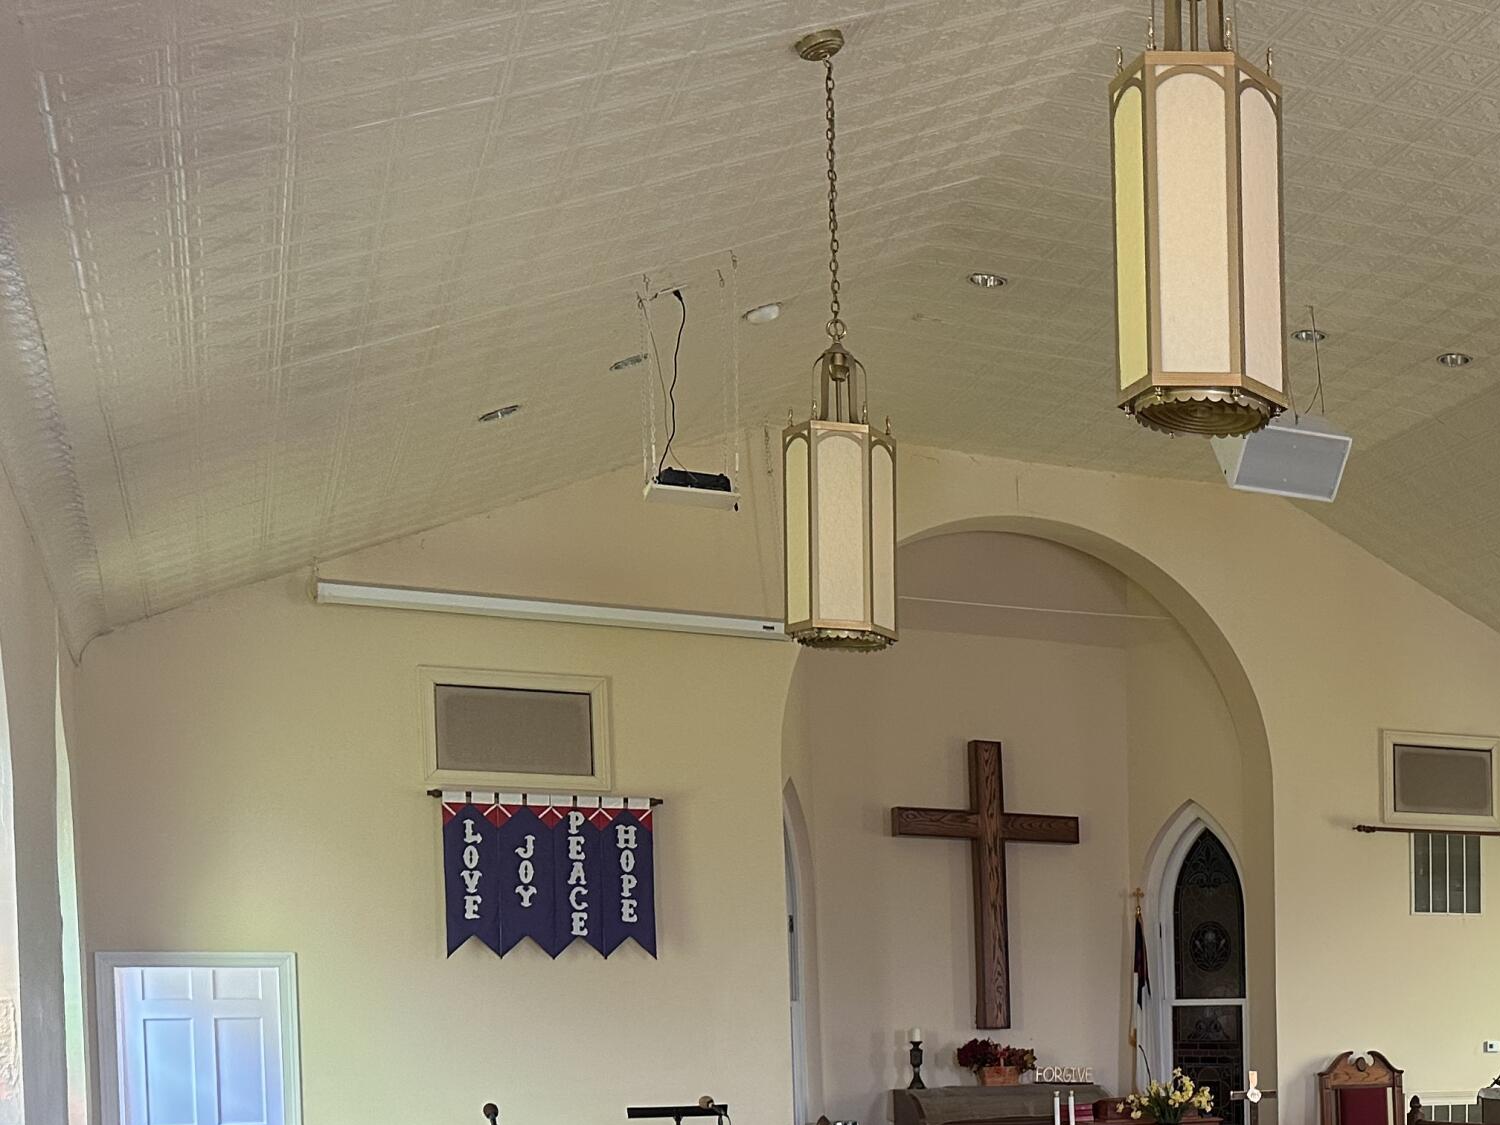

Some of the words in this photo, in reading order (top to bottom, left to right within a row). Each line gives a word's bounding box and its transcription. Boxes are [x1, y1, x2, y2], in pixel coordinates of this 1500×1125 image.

[461, 819, 482, 919] LOVE
[515, 835, 536, 908] JOY
[568, 811, 588, 936] PEACE
[616, 825, 638, 922] HOPE
[1035, 1066, 1093, 1083] FORGIVE
